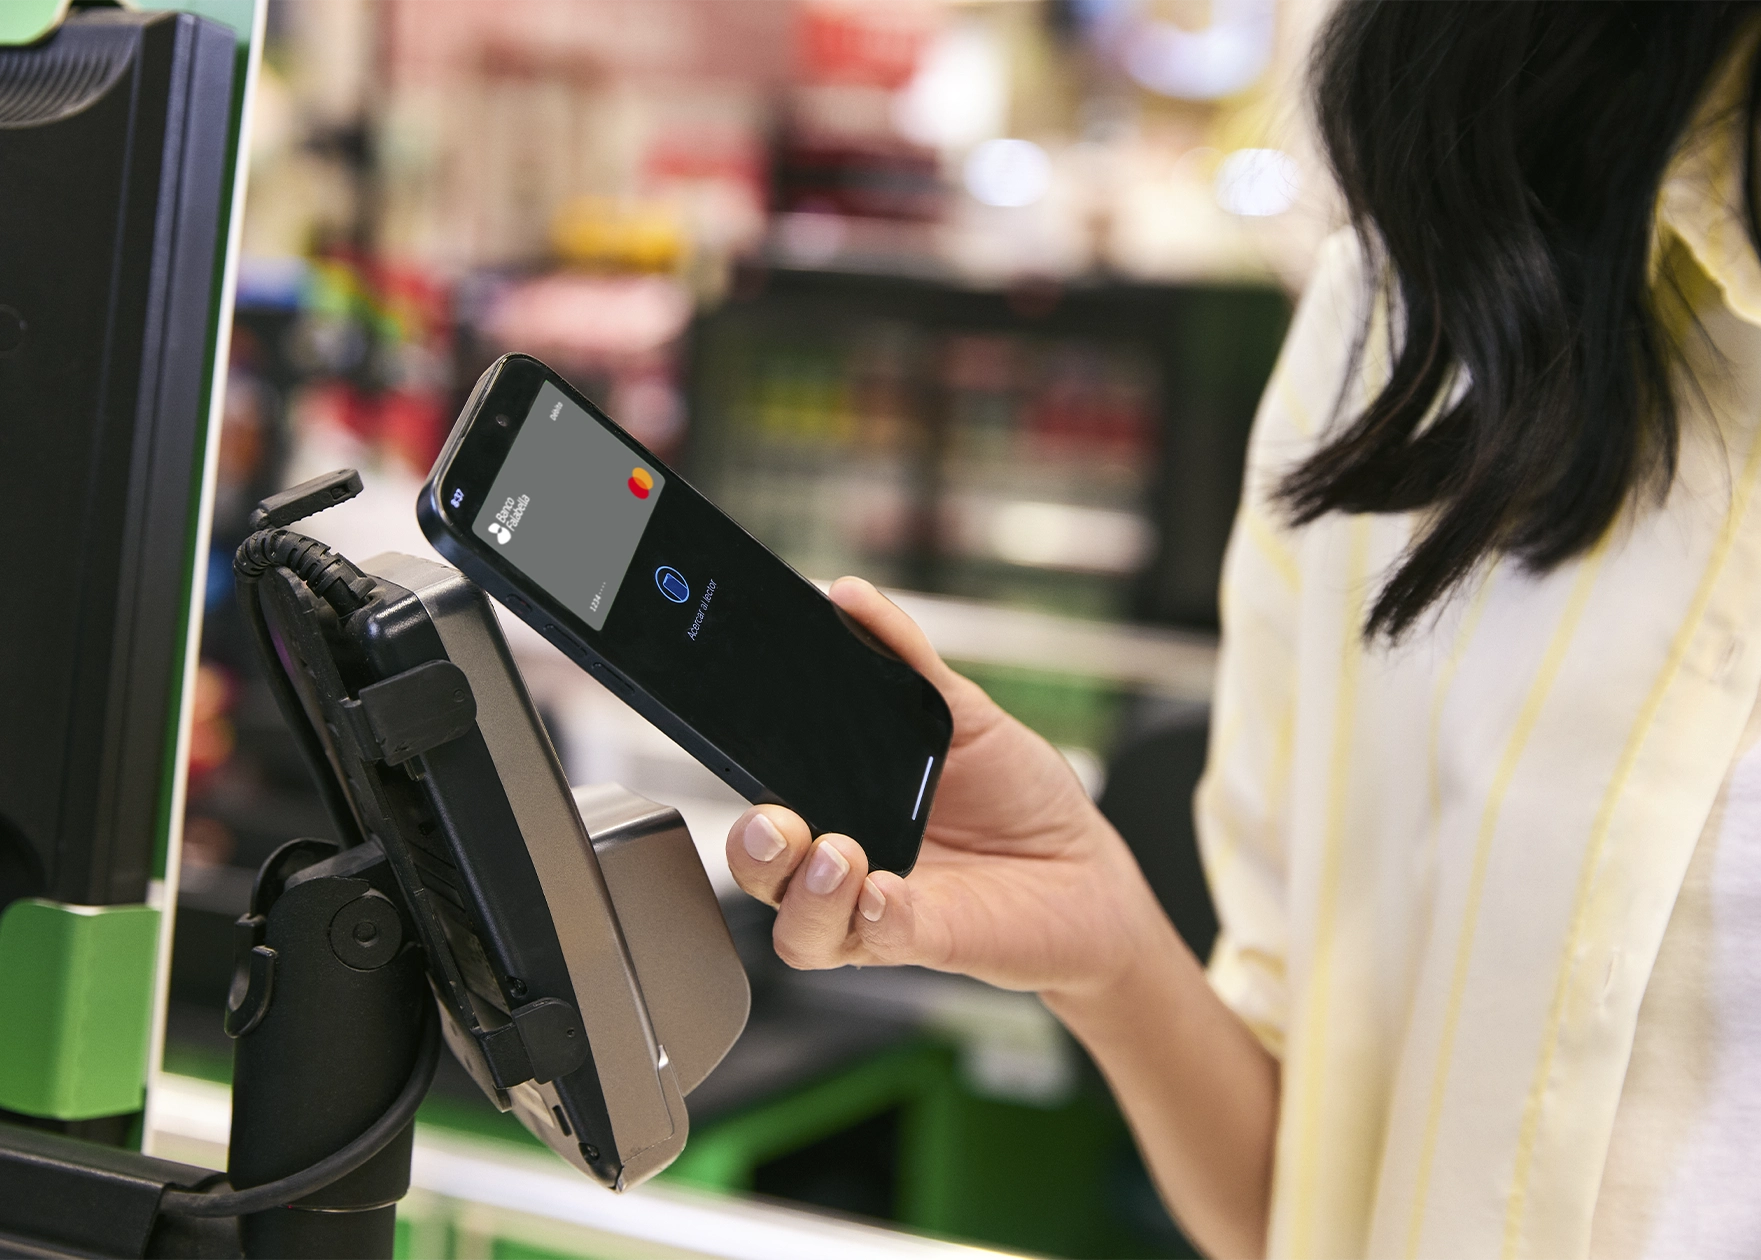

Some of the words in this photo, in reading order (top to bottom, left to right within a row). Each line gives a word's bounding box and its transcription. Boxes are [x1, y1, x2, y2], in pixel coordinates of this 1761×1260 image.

[495, 497, 515, 523] Banco
[506, 494, 530, 532] Falabella
[702, 578, 717, 603] lector
[700, 599, 709, 611] al
[687, 608, 705, 641] Acercar
